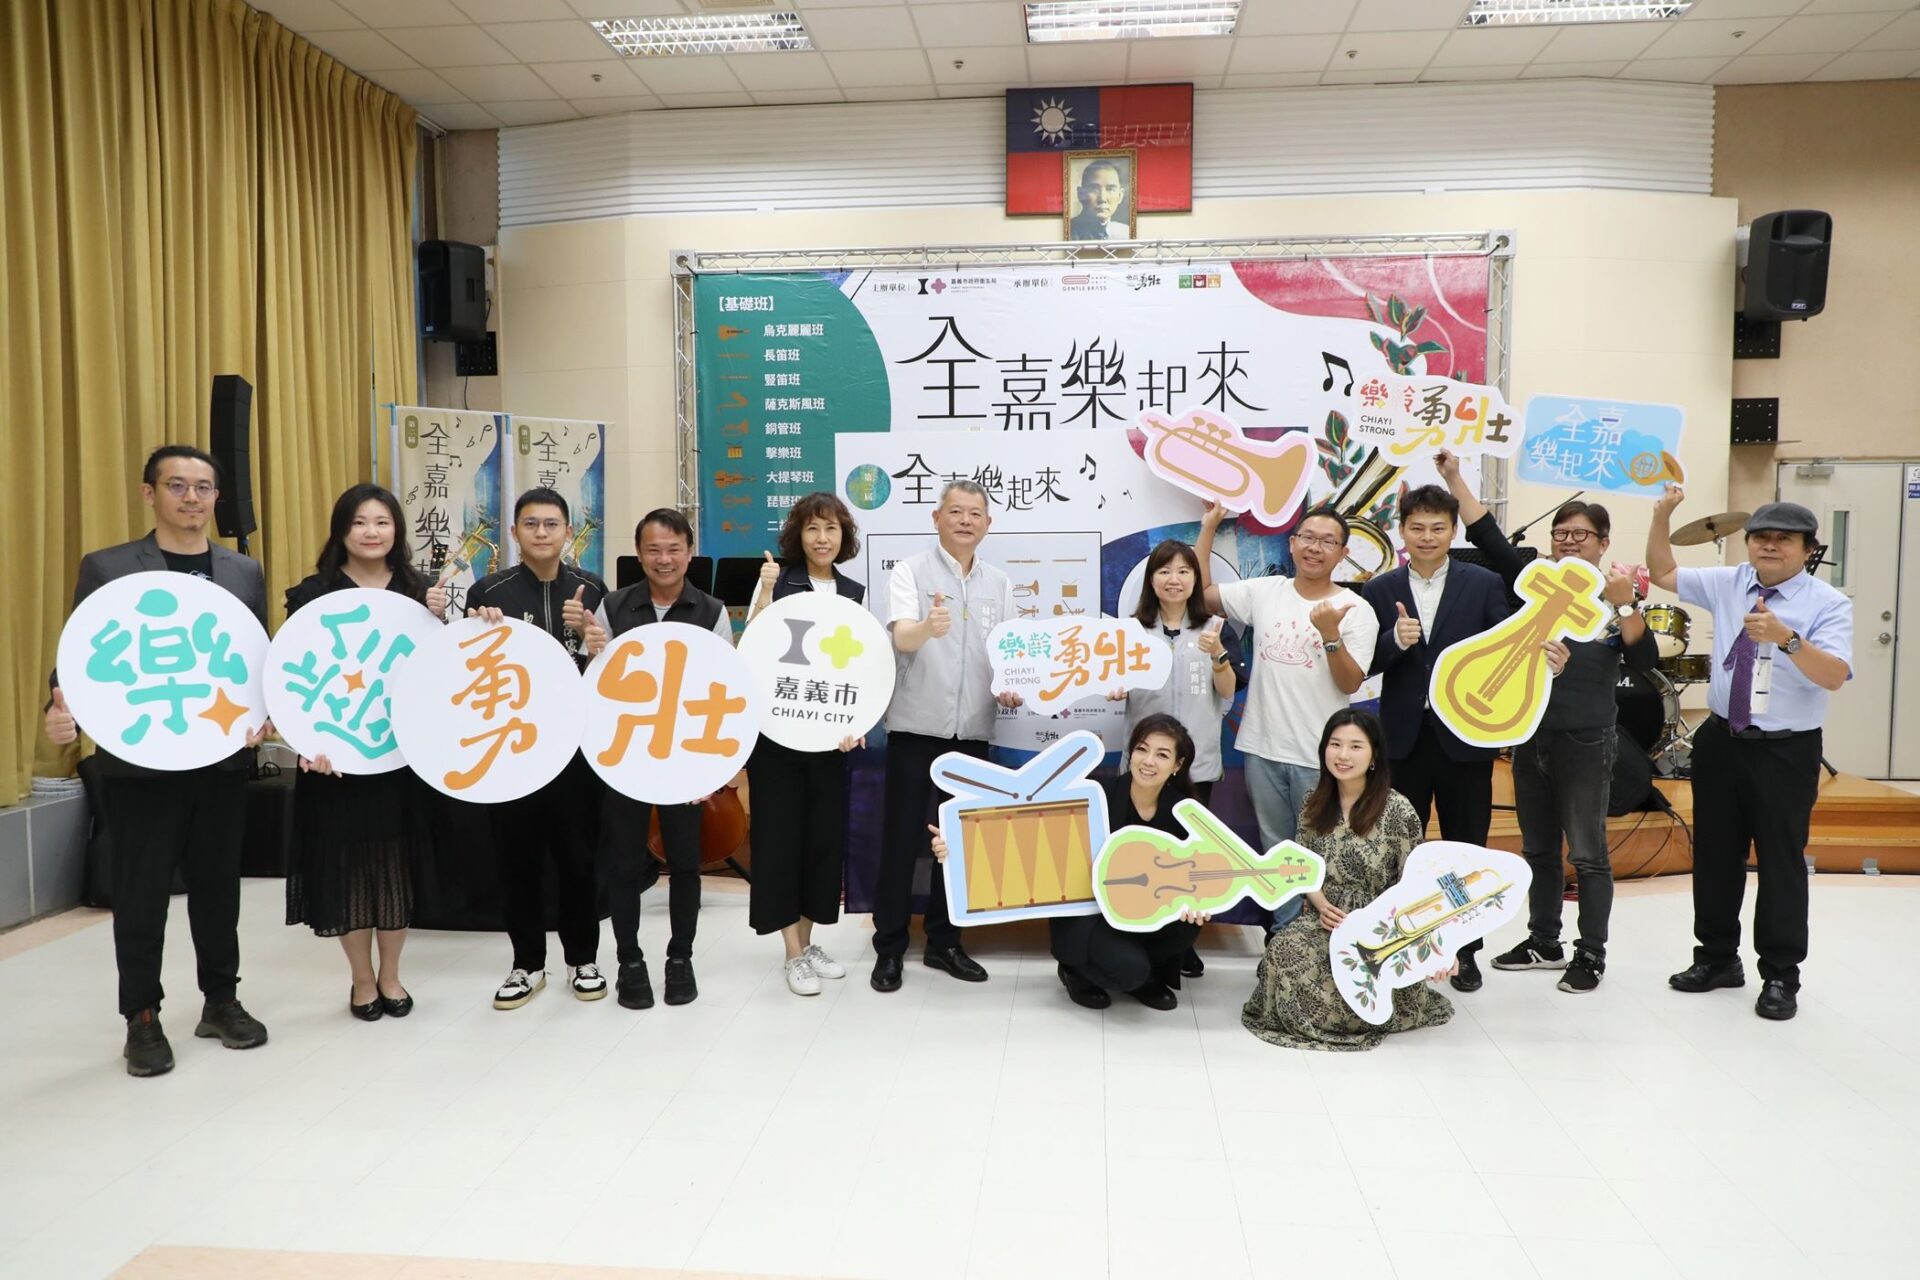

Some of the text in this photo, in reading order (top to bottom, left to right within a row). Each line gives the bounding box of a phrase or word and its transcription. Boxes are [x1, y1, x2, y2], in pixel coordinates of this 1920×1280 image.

[763, 323, 824, 337] 烏克麗麗班
[764, 349, 800, 362] 長笛班
[764, 373, 801, 386] 豎笛班
[764, 398, 826, 411] 薩克斯風班
[1360, 414, 1392, 425] CHIAYI
[765, 422, 802, 435] 銅管班
[1359, 424, 1396, 436] STRONG
[765, 447, 802, 459] 擊樂班
[766, 471, 814, 484] 大提琴班
[86, 589, 250, 746] 樂
[1004, 667, 1036, 676] CHIAYI
[1004, 676, 1041, 686] STRONG
[774, 676, 860, 707] 嘉義市
[443, 625, 538, 790] 勇
[596, 639, 747, 767] 壯
[771, 706, 855, 725] CHIAYI CITY
